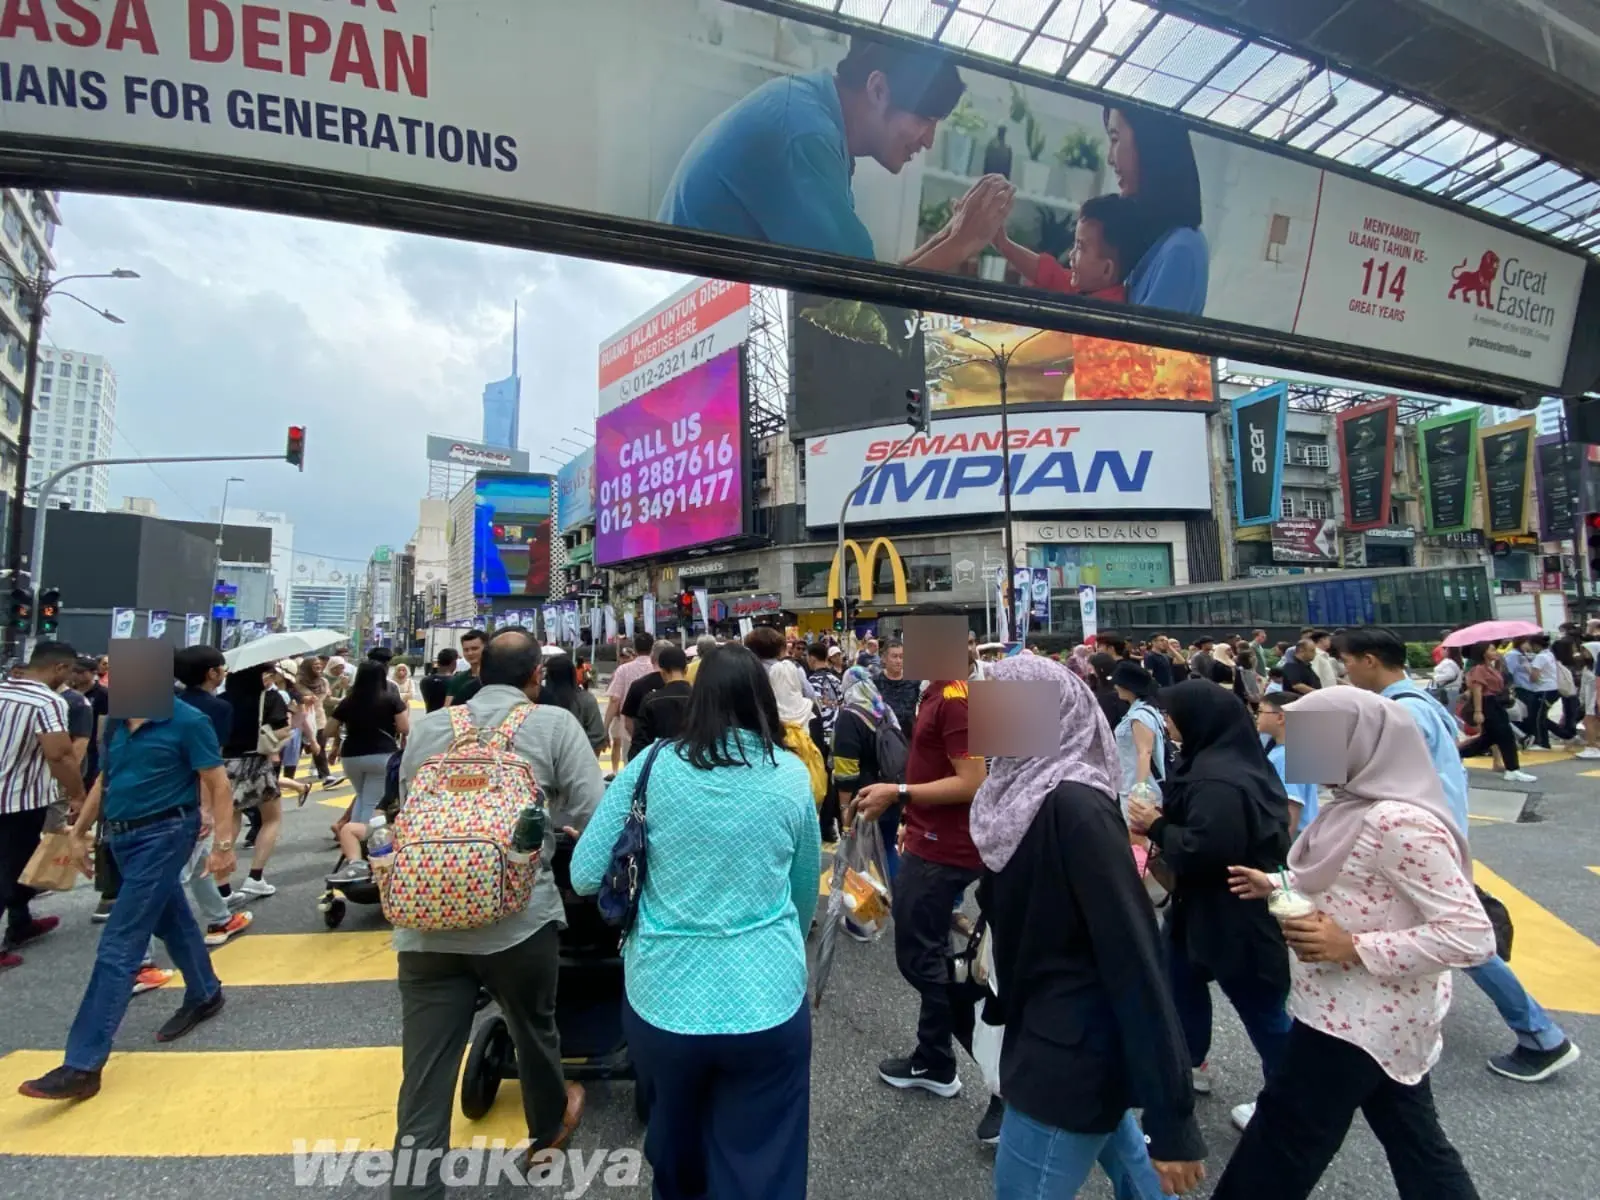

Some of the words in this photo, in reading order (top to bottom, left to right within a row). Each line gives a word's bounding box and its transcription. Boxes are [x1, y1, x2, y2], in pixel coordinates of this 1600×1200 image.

[188, 0, 429, 98] DEPAN
[0, 62, 107, 110] IANS
[124, 76, 210, 124] FOR
[227, 90, 518, 172] GENERATIONS
[1348, 231, 1380, 251] ULANG
[1382, 240, 1412, 260] TAHUN
[1413, 248, 1428, 263] KE-
[1363, 217, 1421, 244] MENYAMBUT
[1362, 257, 1407, 302] 114
[1503, 258, 1547, 295] Great
[904, 310, 964, 339] yang
[1348, 299, 1377, 316] GREAT
[1379, 306, 1405, 322] YEARS
[1496, 286, 1555, 327] Eastern
[600, 339, 629, 367] RUANG
[631, 321, 659, 349] IKLAN
[661, 293, 697, 331] UNTUK
[633, 331, 674, 368] ADVERTISE
[675, 317, 697, 344] HERE
[634, 351, 686, 392] 012-2321
[690, 333, 715, 361] 477
[451, 444, 511, 461] Pioneer
[620, 429, 667, 468] CALL
[672, 412, 702, 447] US
[865, 427, 1080, 462] SEMANGAT
[1250, 422, 1267, 474] acer
[600, 472, 632, 506] 018
[638, 433, 733, 494] 2887616
[852, 450, 1153, 506] IMPIAN
[600, 502, 632, 534] 012
[638, 468, 733, 524] 3491477
[1038, 525, 1160, 540] GIORDANO
[678, 562, 724, 577] McDonald's
